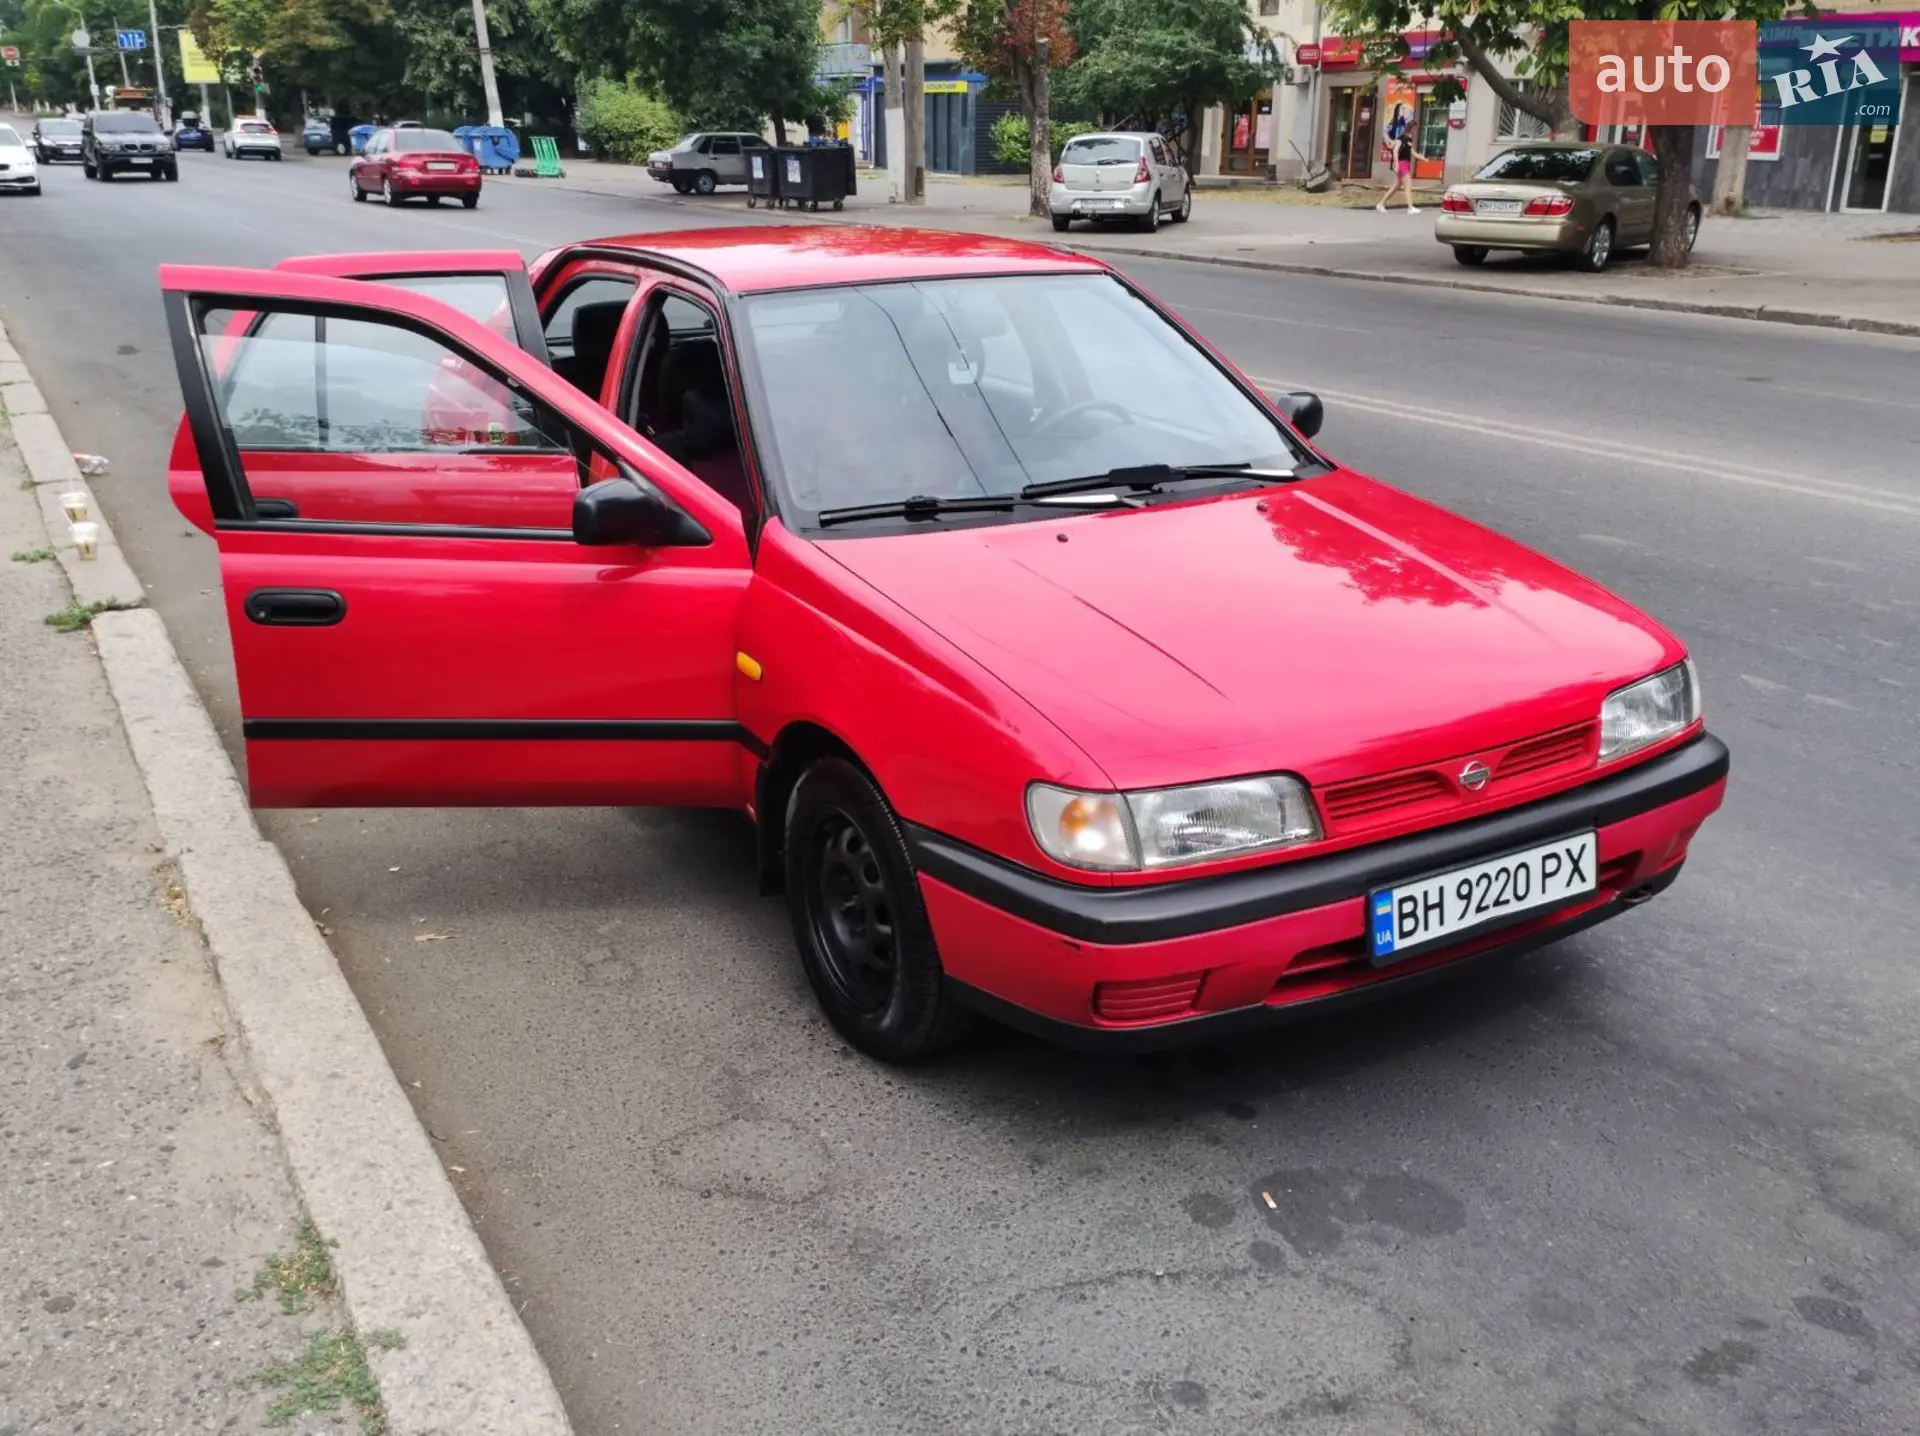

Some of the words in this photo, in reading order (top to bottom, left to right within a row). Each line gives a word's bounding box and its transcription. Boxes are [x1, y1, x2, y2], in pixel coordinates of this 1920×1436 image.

[1398, 885, 1444, 940] BH
[1456, 861, 1530, 921] 9220
[1541, 843, 1586, 895] PX
[1377, 929, 1392, 945] UA
